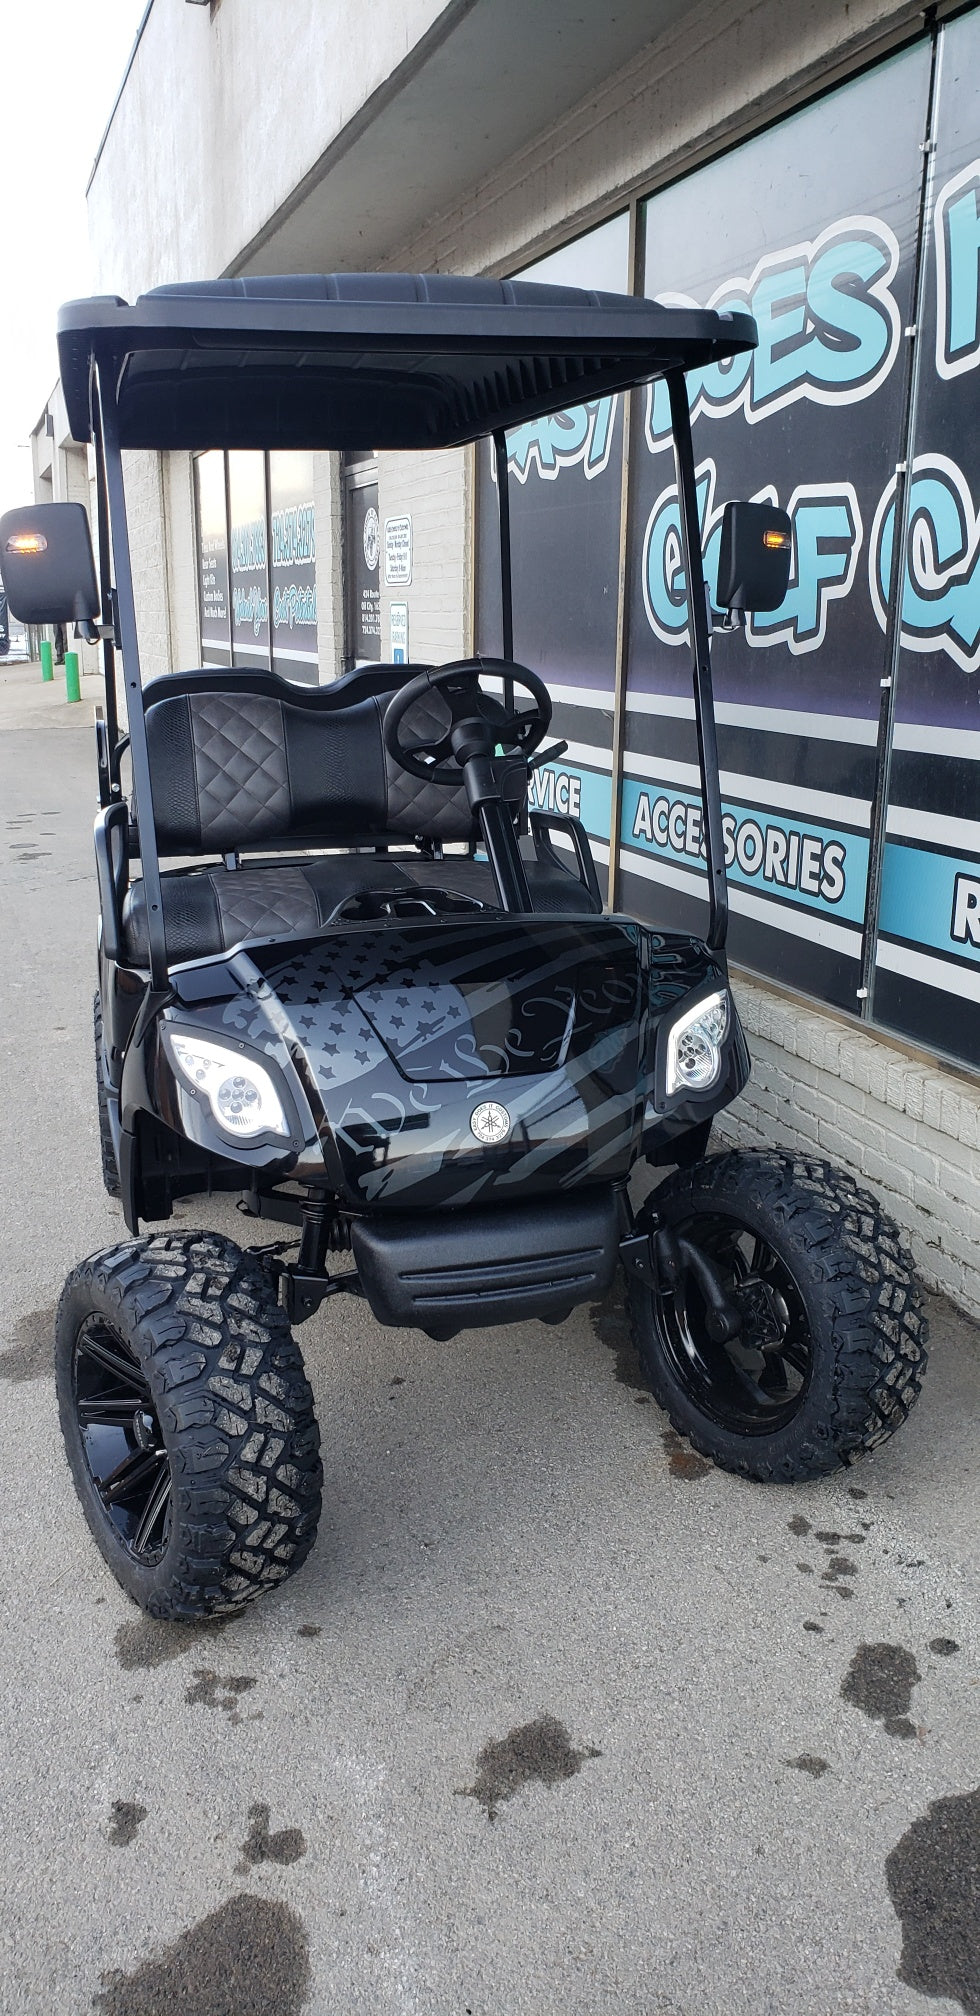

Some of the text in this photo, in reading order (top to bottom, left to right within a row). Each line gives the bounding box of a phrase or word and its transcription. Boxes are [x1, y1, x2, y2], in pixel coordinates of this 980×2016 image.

[490, 392, 618, 482] ASY
[642, 458, 863, 656] GF
[632, 793, 847, 904] ACCESORIES
[474, 1104, 487, 1116] DOES
